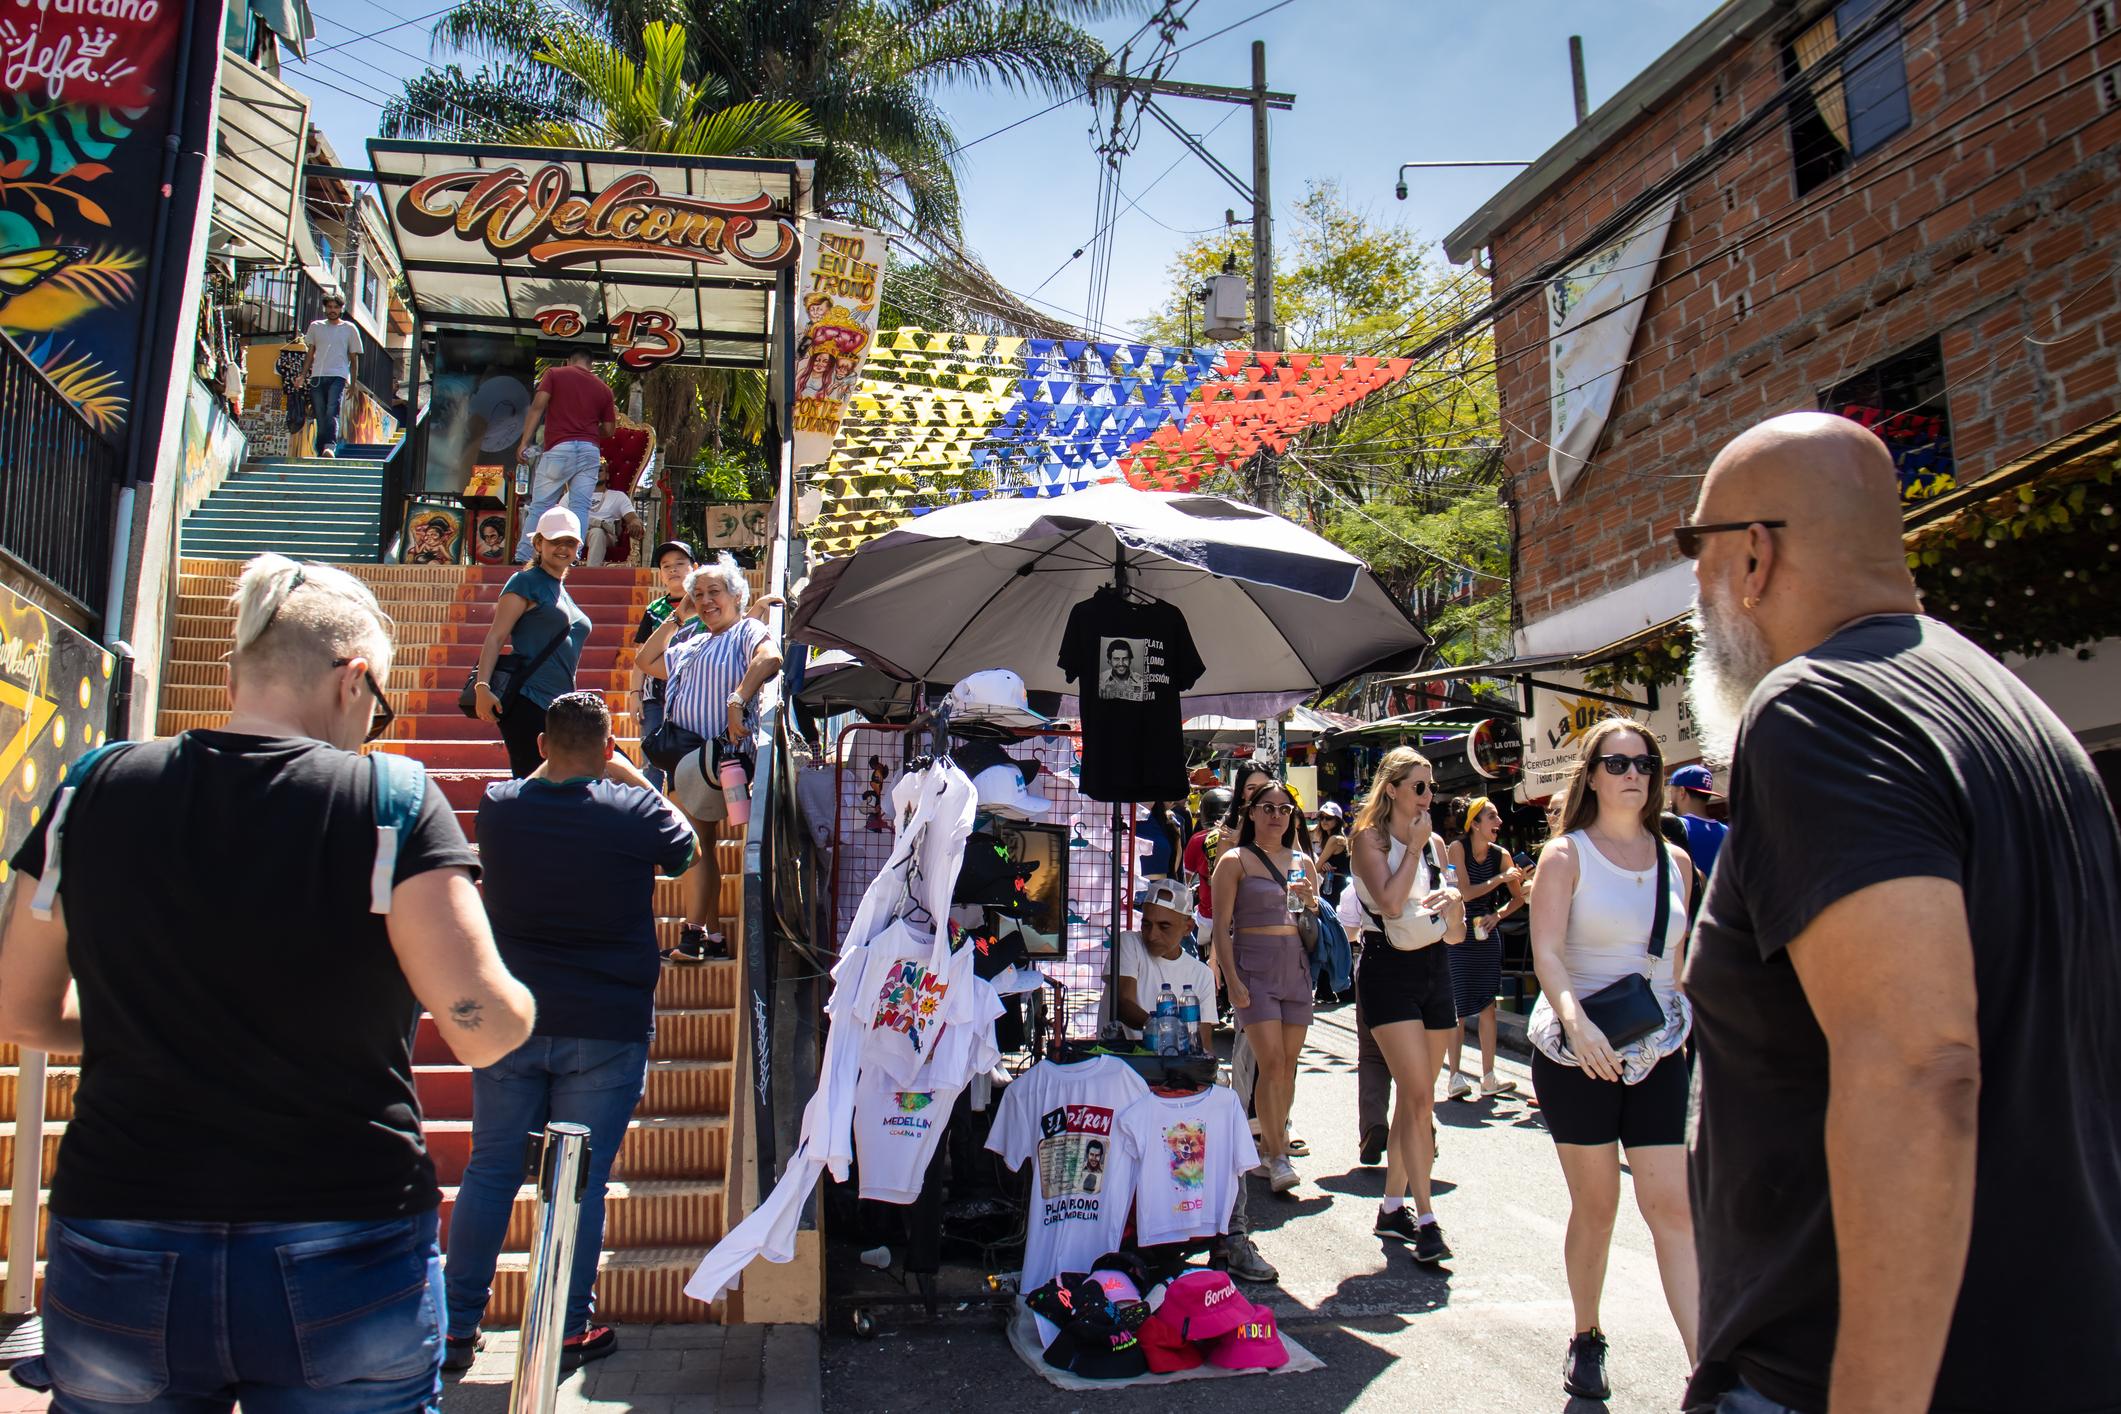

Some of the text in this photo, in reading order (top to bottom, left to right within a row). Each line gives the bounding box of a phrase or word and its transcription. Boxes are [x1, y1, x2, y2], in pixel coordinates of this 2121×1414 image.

[397, 162, 801, 270] Welcome
[818, 253, 847, 276] EN
[810, 268, 877, 304] TRONO
[609, 305, 686, 373] 13
[1144, 638, 1164, 650] PLATA
[1503, 740, 1520, 748] OTRA
[1547, 715, 1570, 750] La
[1526, 758, 1555, 770] CERVEZA
[1556, 753, 1577, 765] MICHE
